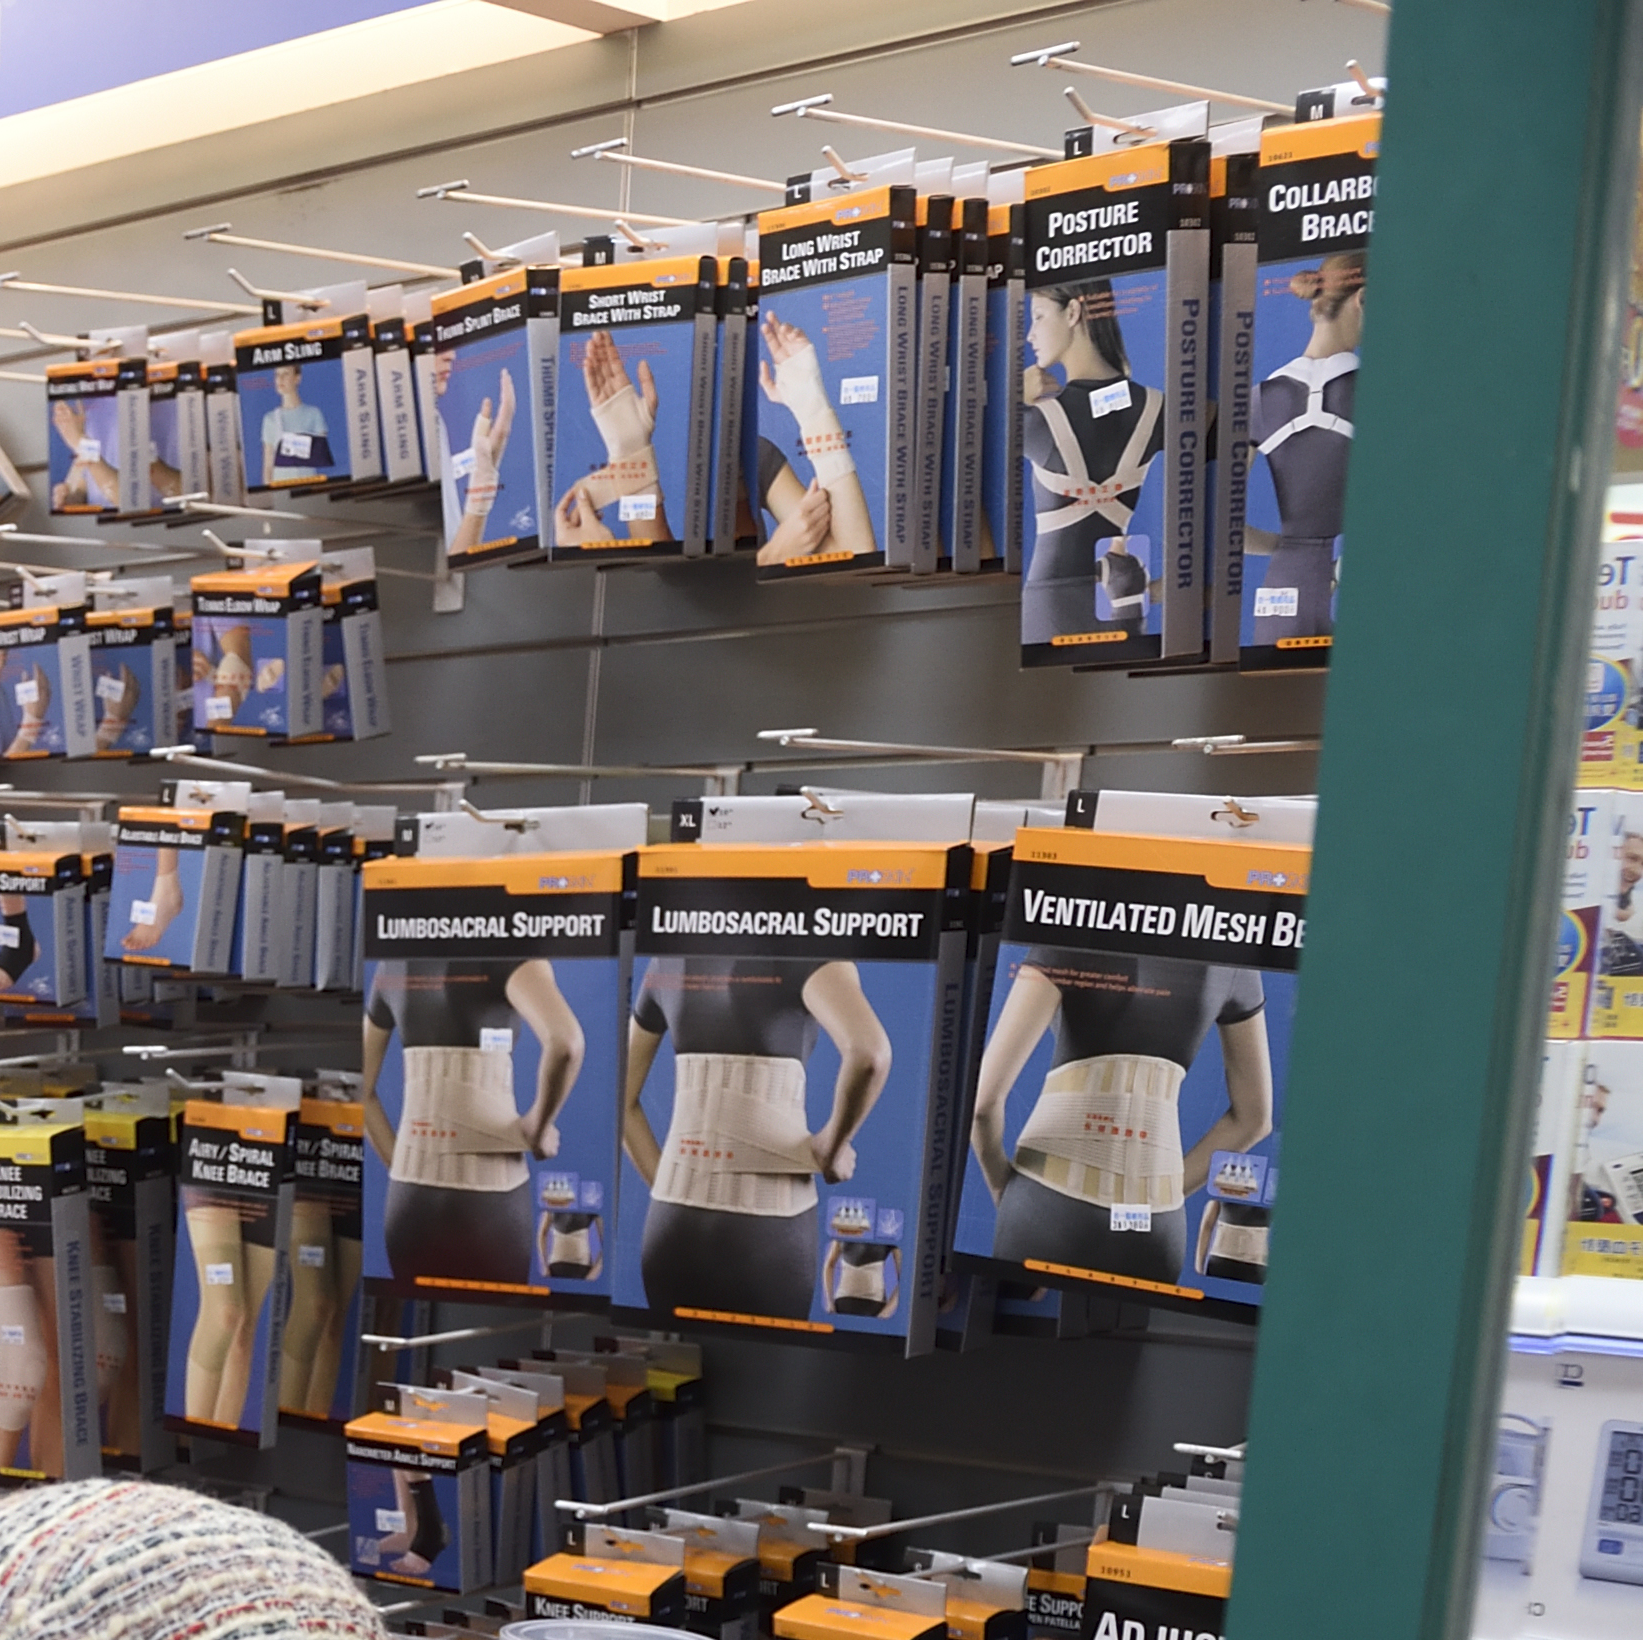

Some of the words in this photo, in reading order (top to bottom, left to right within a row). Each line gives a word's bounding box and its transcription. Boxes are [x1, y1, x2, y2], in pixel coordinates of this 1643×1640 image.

[1309, 104, 1324, 121] M
[1072, 140, 1083, 156] L
[793, 182, 803, 200] L
[1268, 174, 1379, 214] COLLARB
[1048, 200, 1140, 239] POSTURE
[781, 238, 816, 262] LONG
[816, 230, 861, 256] WRIST
[1035, 231, 1153, 273] CORRECTOR
[761, 262, 801, 288] BRACE
[803, 257, 838, 281] WITH
[840, 248, 885, 273] STRAP
[266, 304, 276, 320] L
[572, 311, 609, 328] BRACE
[610, 307, 642, 324] WITH
[642, 303, 682, 321] STRAP
[588, 293, 625, 310] SHORT
[626, 289, 666, 306] WRIST
[897, 286, 908, 325] LONG
[252, 347, 283, 365] ARM
[284, 342, 323, 361] SLING
[897, 330, 908, 385] WRIST
[1178, 298, 1201, 423] POSTURE
[1231, 311, 1254, 434] POSTURE
[897, 389, 908, 444] BRACE
[896, 448, 907, 491] WITH
[894, 494, 906, 544] STRAP
[1177, 428, 1197, 590] CORRECTOR
[1227, 440, 1248, 597] CORRECTOR
[679, 814, 697, 828] XL
[1076, 798, 1085, 814] L
[0, 873, 47, 892] SUPPORT
[377, 913, 510, 940] LUMBOSACRAL
[512, 910, 606, 938] SUPPORT
[651, 905, 809, 936] LUMBOSACRAL
[812, 907, 924, 938] SUPPORT
[1022, 888, 1177, 936] VENTILATED
[1181, 903, 1267, 945] MESH
[929, 982, 959, 1177] LUMBOSACRAL
[191, 1162, 226, 1182] KNEE
[227, 1163, 271, 1188] BRACE
[295, 1159, 317, 1177] NEE
[920, 1181, 944, 1300] SUPPORT
[1121, 1504, 1130, 1519] L
[567, 1530, 576, 1546] L
[820, 1572, 830, 1588] L
[533, 1597, 570, 1619] KNEE
